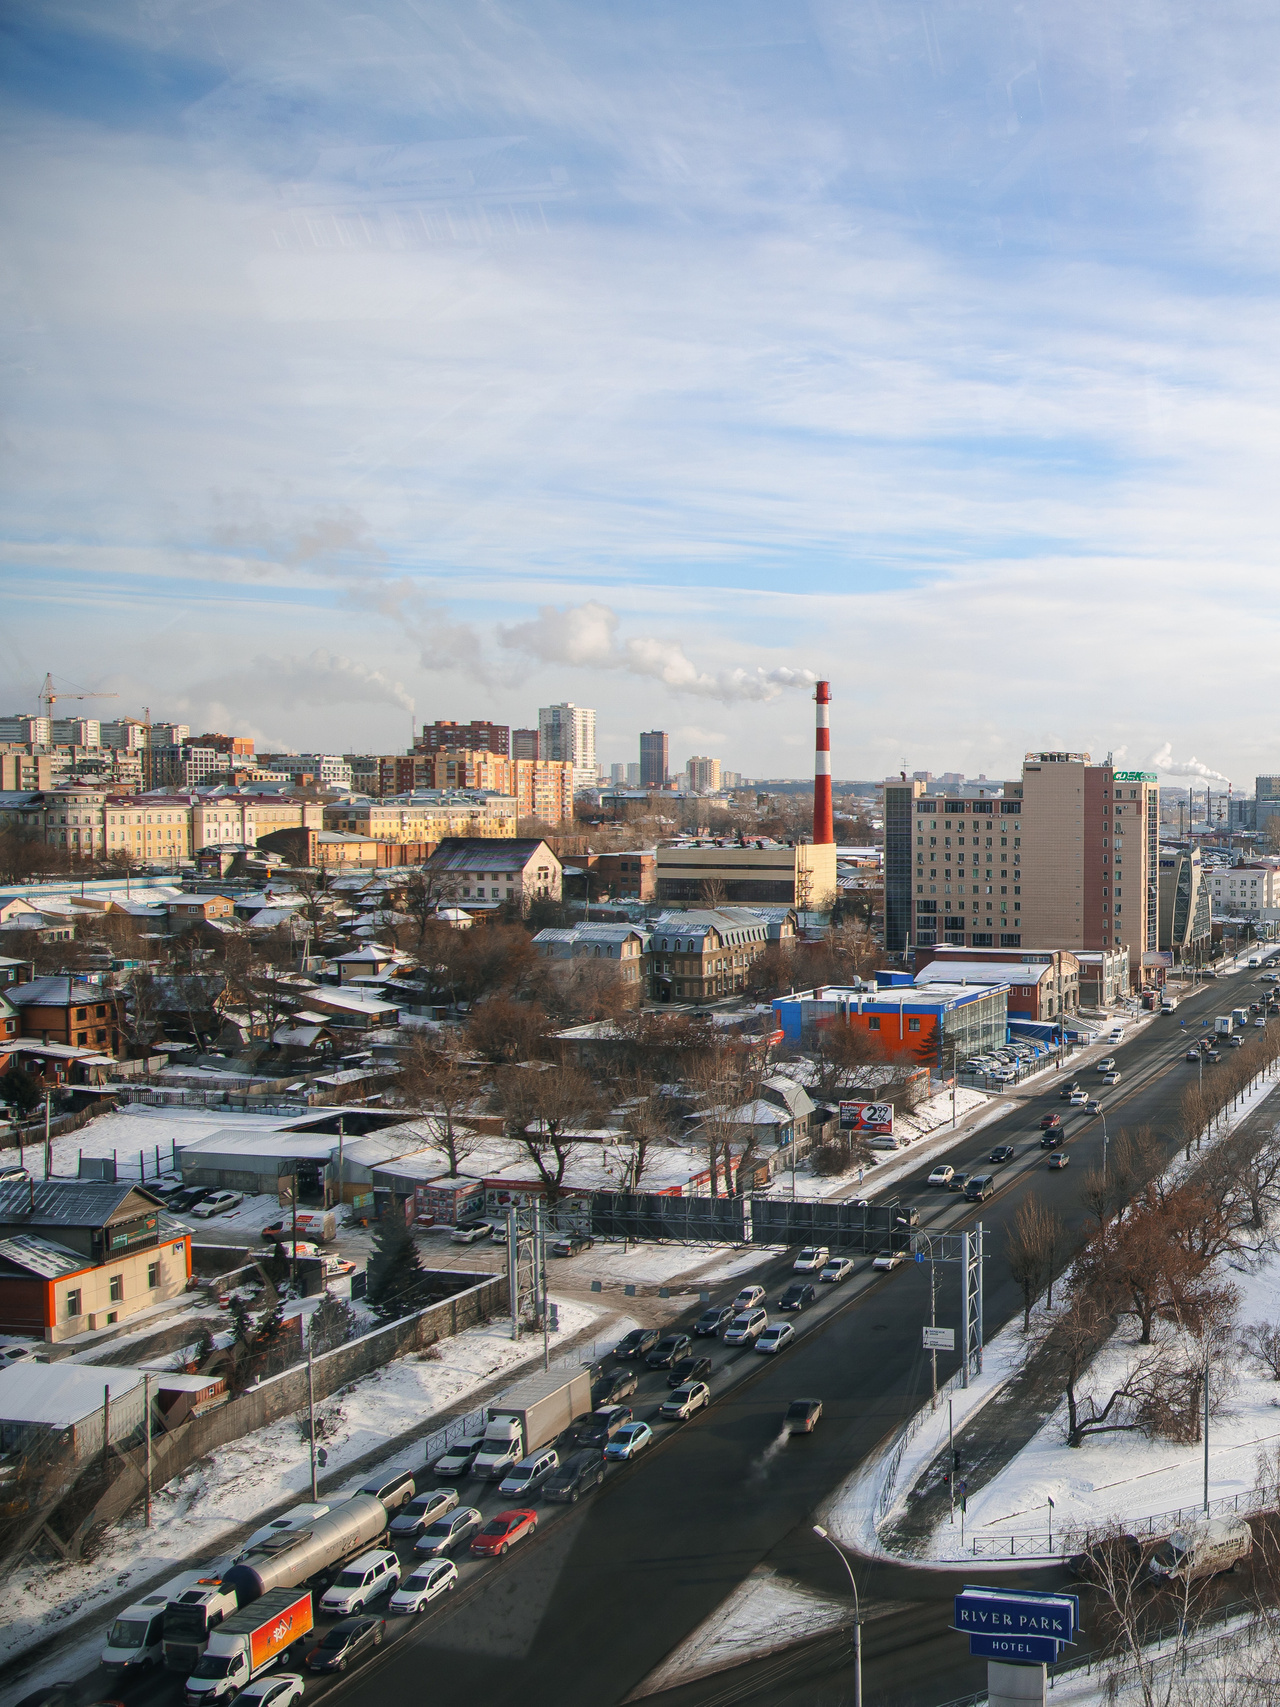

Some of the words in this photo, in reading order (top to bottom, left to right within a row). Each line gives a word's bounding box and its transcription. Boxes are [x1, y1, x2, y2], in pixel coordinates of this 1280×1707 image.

[960, 1609, 1013, 1626] RIVER
[1019, 1615, 1063, 1631] PARK
[992, 1641, 1032, 1653] HOTEL
